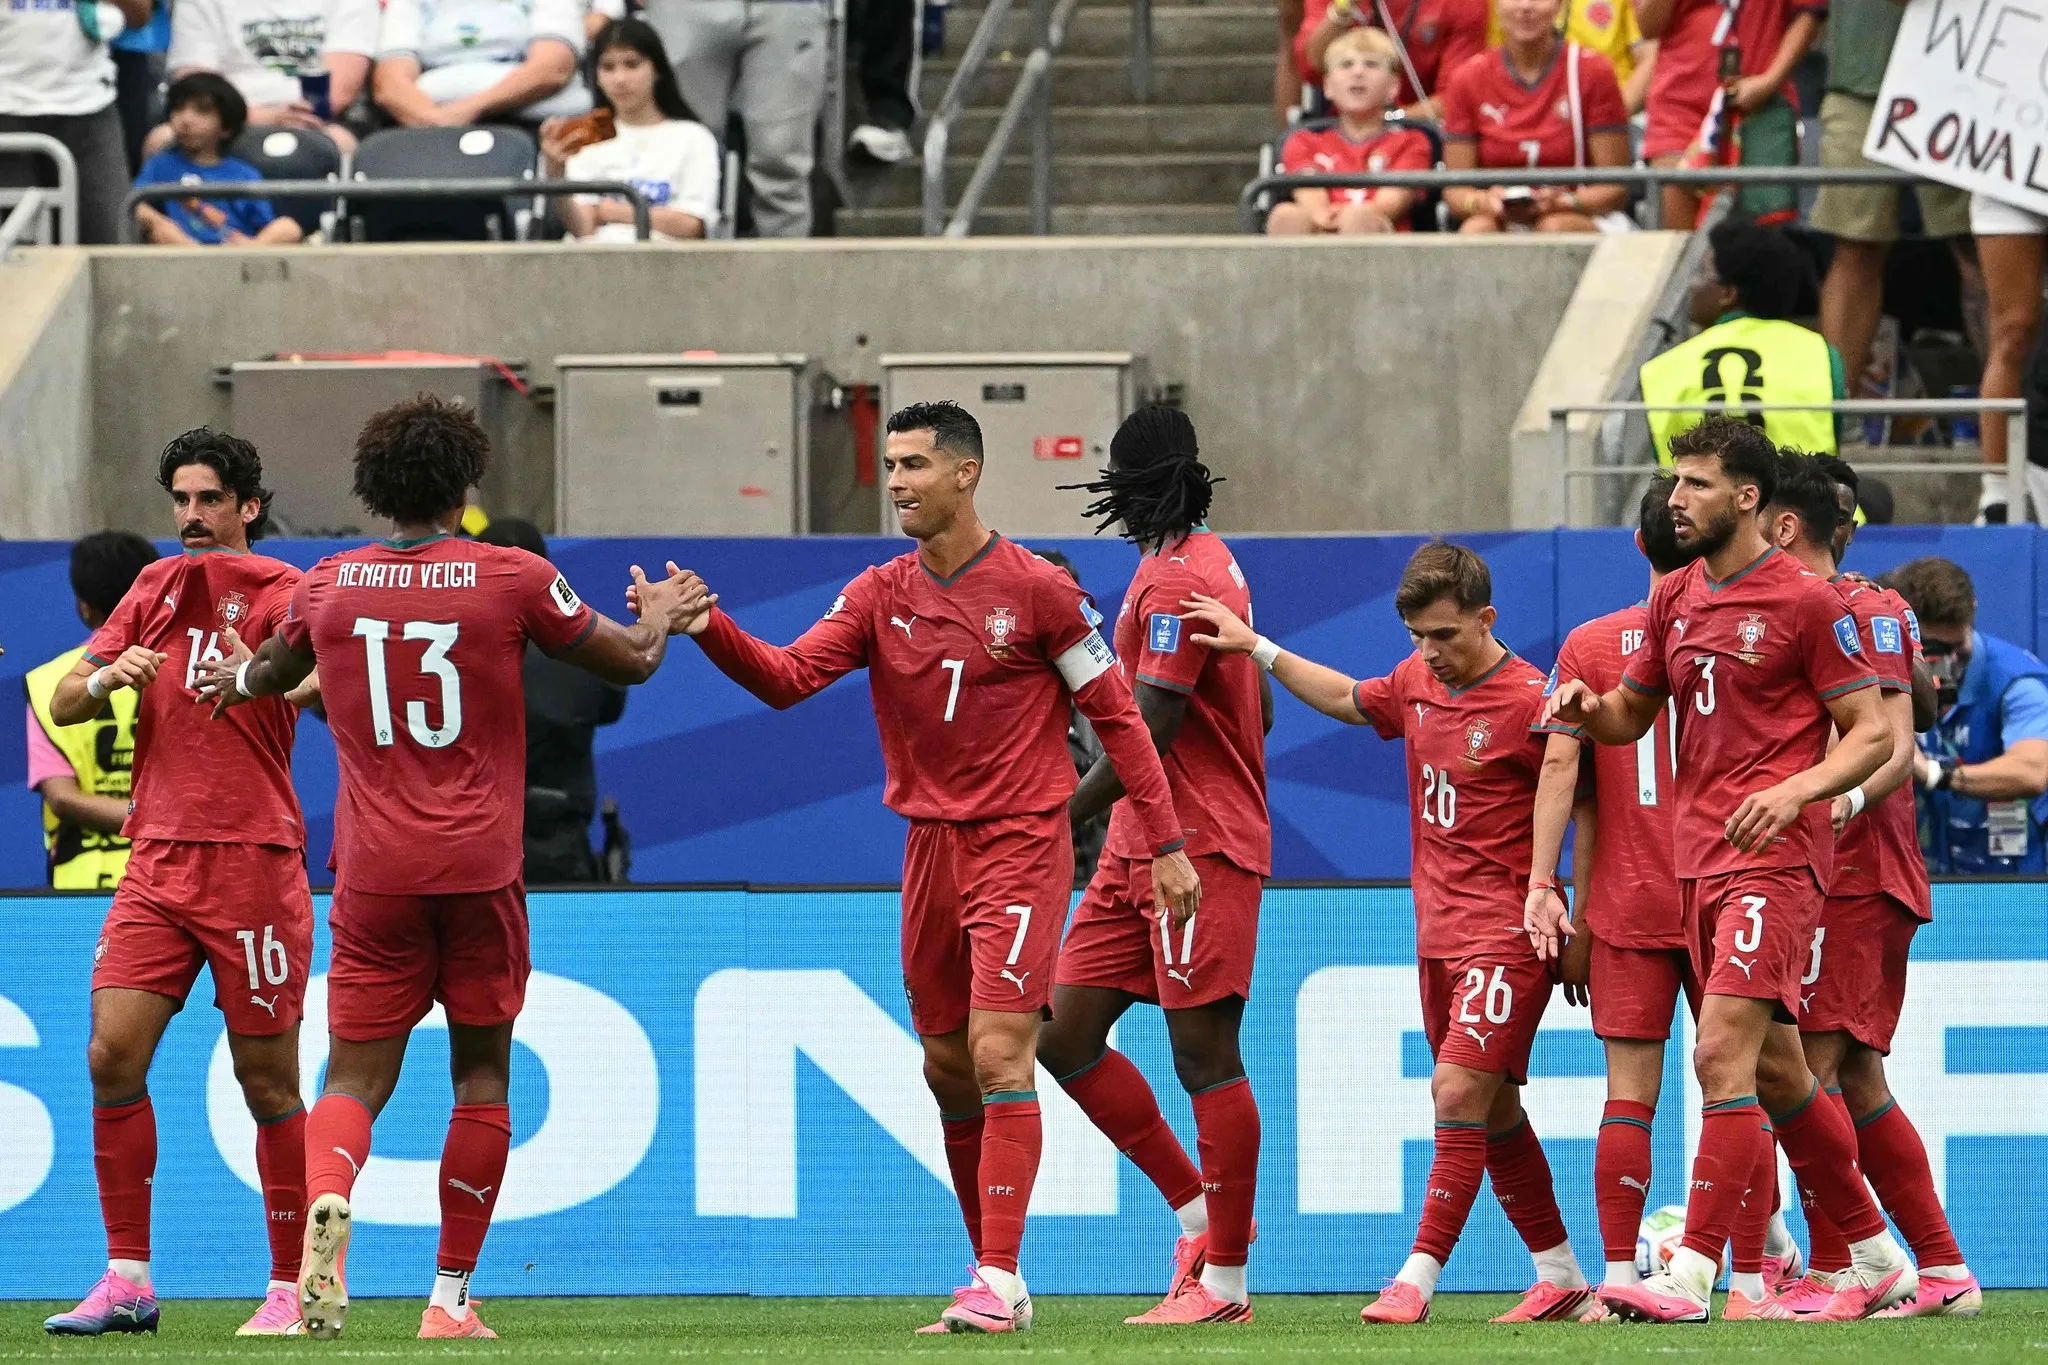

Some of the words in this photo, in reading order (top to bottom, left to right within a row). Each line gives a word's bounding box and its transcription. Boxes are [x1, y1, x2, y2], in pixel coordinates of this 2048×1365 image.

[1923, 0, 2043, 88] WE
[1877, 97, 2048, 193] RONAL
[336, 563, 413, 588] RENATO
[420, 562, 476, 588] VEIGA
[185, 627, 223, 692] 16
[352, 617, 462, 748] 13
[942, 659, 965, 722] 7
[1694, 655, 1716, 716] 3
[1422, 763, 1456, 828] 26
[1005, 905, 1033, 965] 7
[1734, 895, 1767, 953] 3
[236, 925, 288, 990] 16
[1457, 965, 1513, 1024] 26
